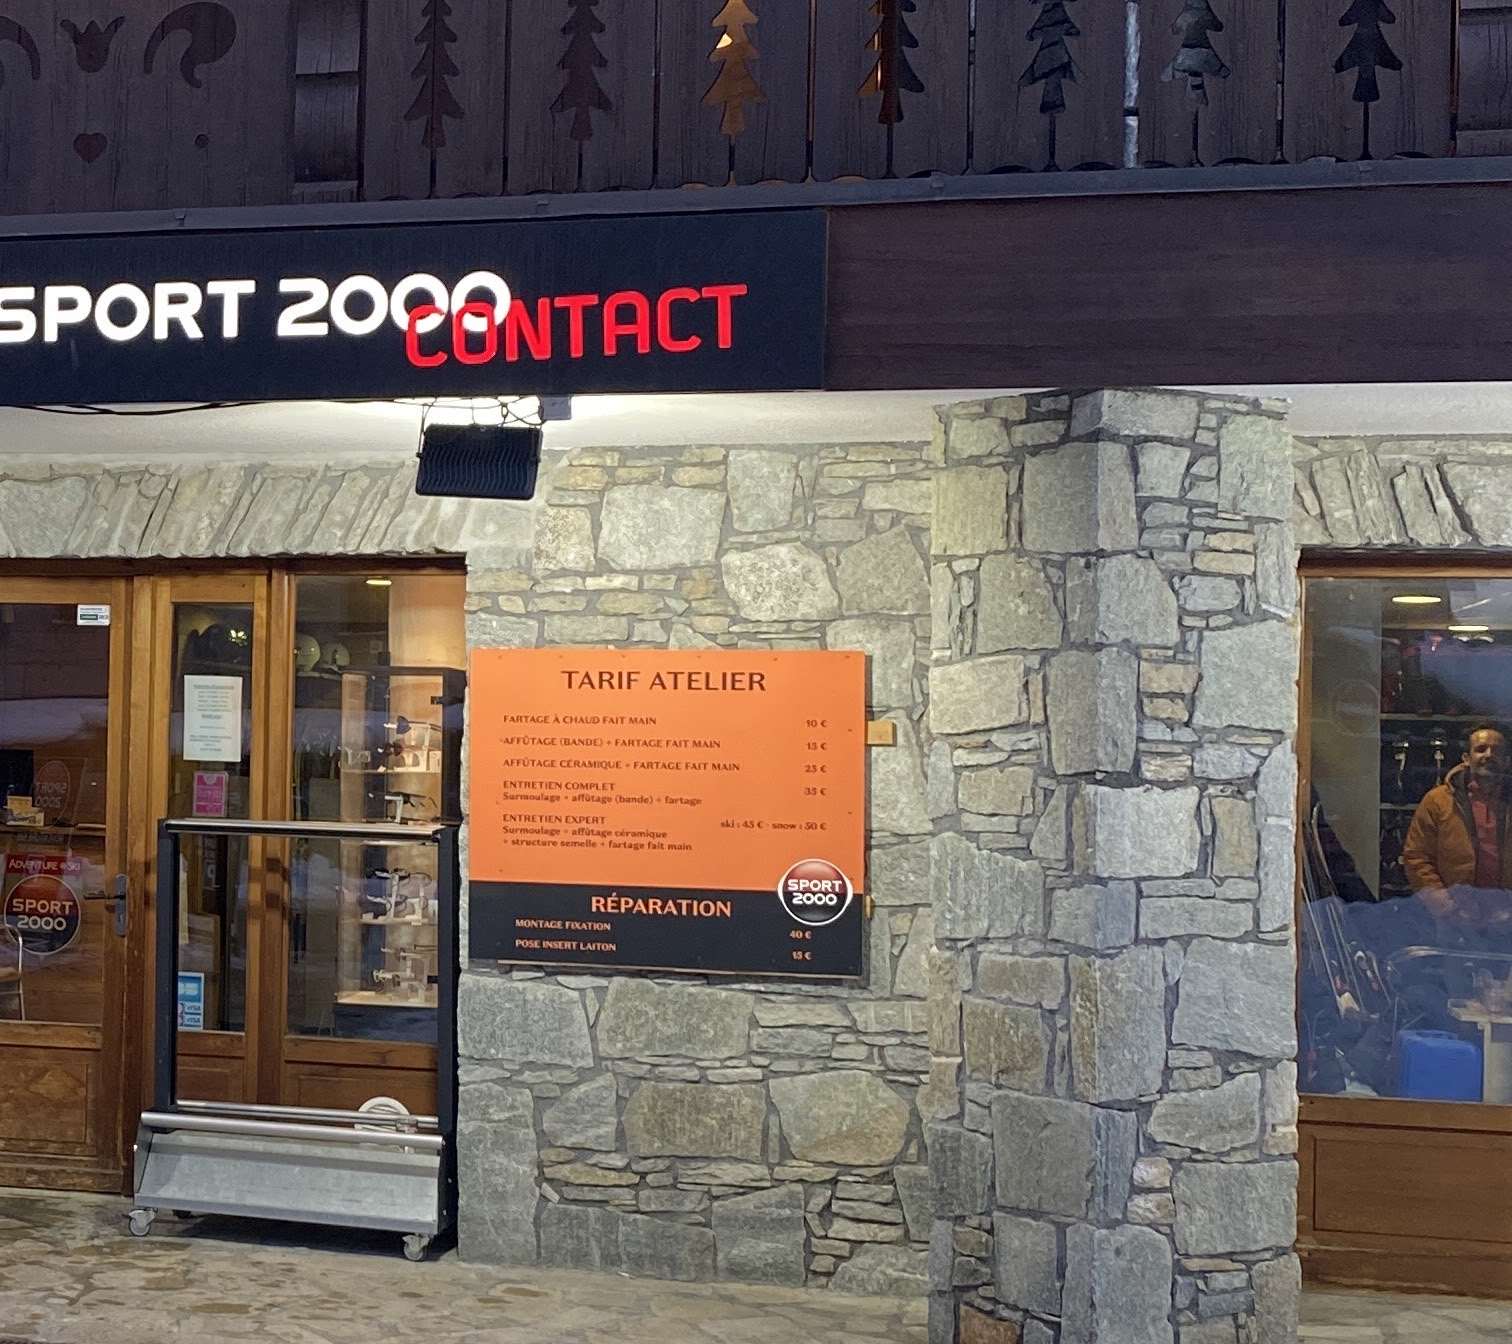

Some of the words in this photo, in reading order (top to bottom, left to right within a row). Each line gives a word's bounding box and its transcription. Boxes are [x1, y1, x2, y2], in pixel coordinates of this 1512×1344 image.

[278, 271, 511, 336] 2000
[406, 283, 748, 367] CONTACT
[560, 670, 640, 690] TARIF
[649, 671, 767, 692] ATELIER
[503, 715, 550, 724] FARTAGE
[562, 716, 600, 724] CHAUD
[602, 716, 626, 725] FAIT
[628, 716, 657, 725] MAIN
[806, 719, 817, 728] 10
[559, 737, 603, 747] (BANDE)
[615, 739, 663, 748] FARTAGE
[666, 739, 689, 748] FAIT
[692, 740, 721, 749] MAIN
[633, 761, 682, 771] FARTAGE
[685, 762, 708, 771] FAIT
[711, 762, 740, 772] MAIN
[503, 781, 562, 790] ENTRETIEN
[565, 782, 616, 791] COMPLET
[665, 796, 702, 806] fartage
[503, 814, 562, 823] ENTRETIEN
[565, 815, 606, 824] EXPERT
[511, 839, 558, 847] structure
[560, 839, 597, 848] semelle
[608, 840, 645, 850] fartage
[647, 841, 665, 850] fait
[667, 842, 692, 851] main
[8, 859, 58, 871] ADVENTURE
[67, 862, 81, 871] SKI
[787, 879, 842, 892] SPORT
[792, 892, 837, 905] 2000
[12, 898, 73, 915] SPORT
[591, 892, 731, 918] RÉPARATION
[17, 915, 67, 931] 2000
[515, 919, 563, 930] MONTAGE
[565, 920, 611, 931] FIXATION
[789, 930, 803, 939] 40
[515, 939, 540, 948] POSE
[543, 940, 577, 950] INSERT
[580, 941, 616, 951] LAITON
